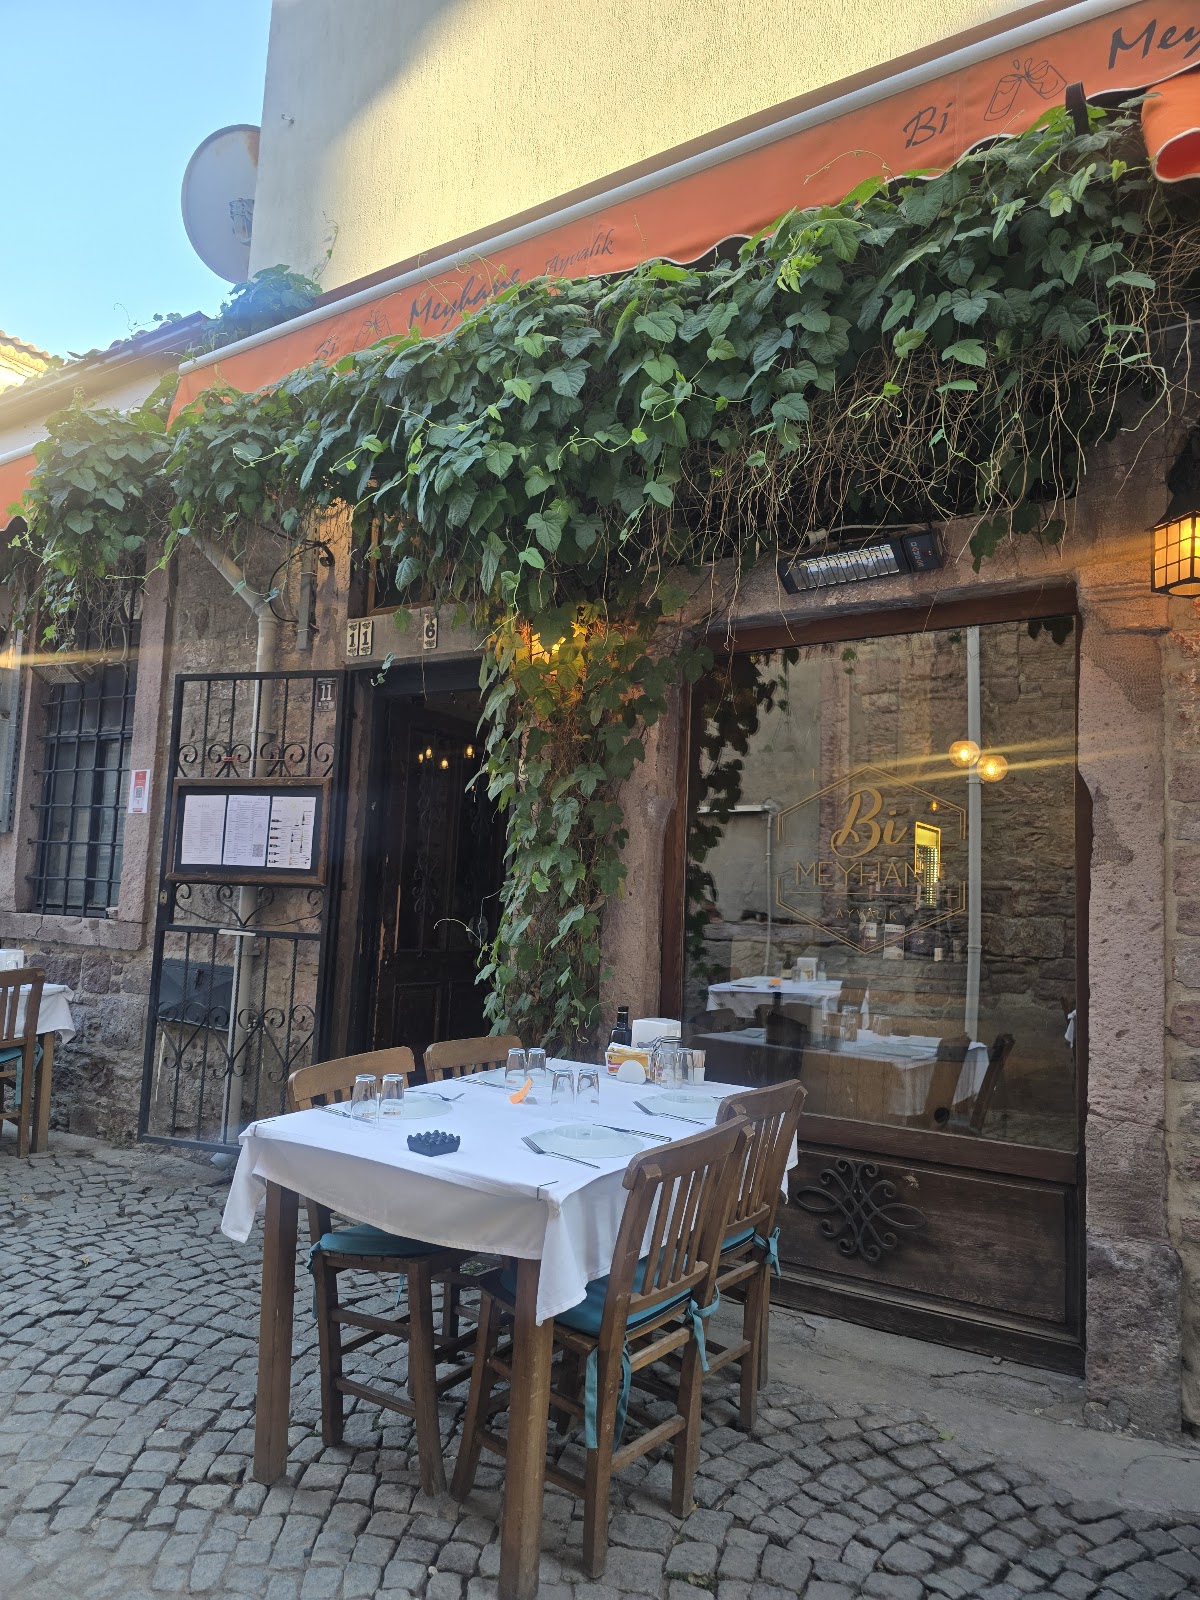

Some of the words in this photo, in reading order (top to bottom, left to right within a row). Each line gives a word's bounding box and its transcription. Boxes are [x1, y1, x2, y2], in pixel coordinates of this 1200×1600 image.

[902, 102, 953, 149] Bi
[408, 268, 521, 331] Meyhane
[425, 622, 436, 639] 6
[320, 684, 332, 701] 11
[830, 787, 908, 858] Bi
